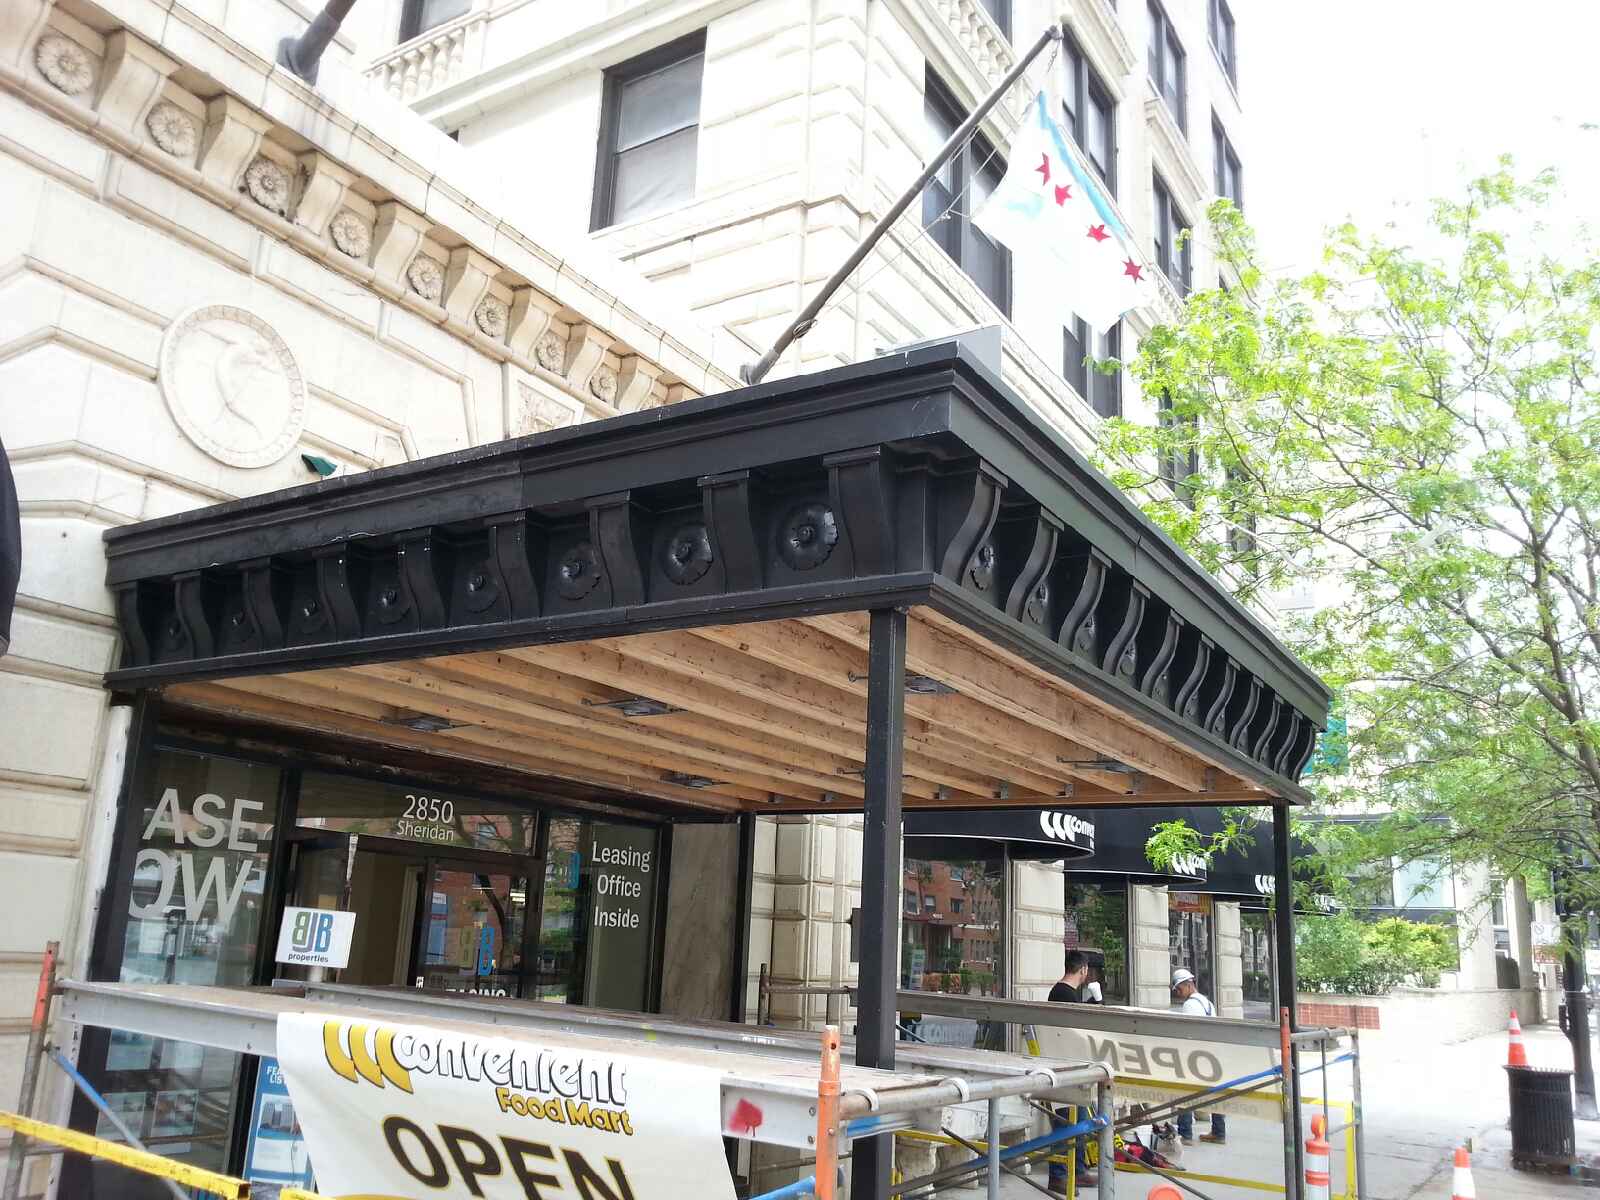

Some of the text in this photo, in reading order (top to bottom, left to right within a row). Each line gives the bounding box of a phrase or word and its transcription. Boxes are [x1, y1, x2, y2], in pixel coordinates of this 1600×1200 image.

[402, 794, 454, 824] 2850
[396, 820, 455, 841] Sheridan
[592, 841, 651, 872] Leasing
[597, 874, 641, 898] Office
[594, 905, 640, 929] Inside
[287, 952, 329, 963] properties
[495, 1086, 634, 1136] Food Mart
[382, 1115, 636, 1200] OPEN
